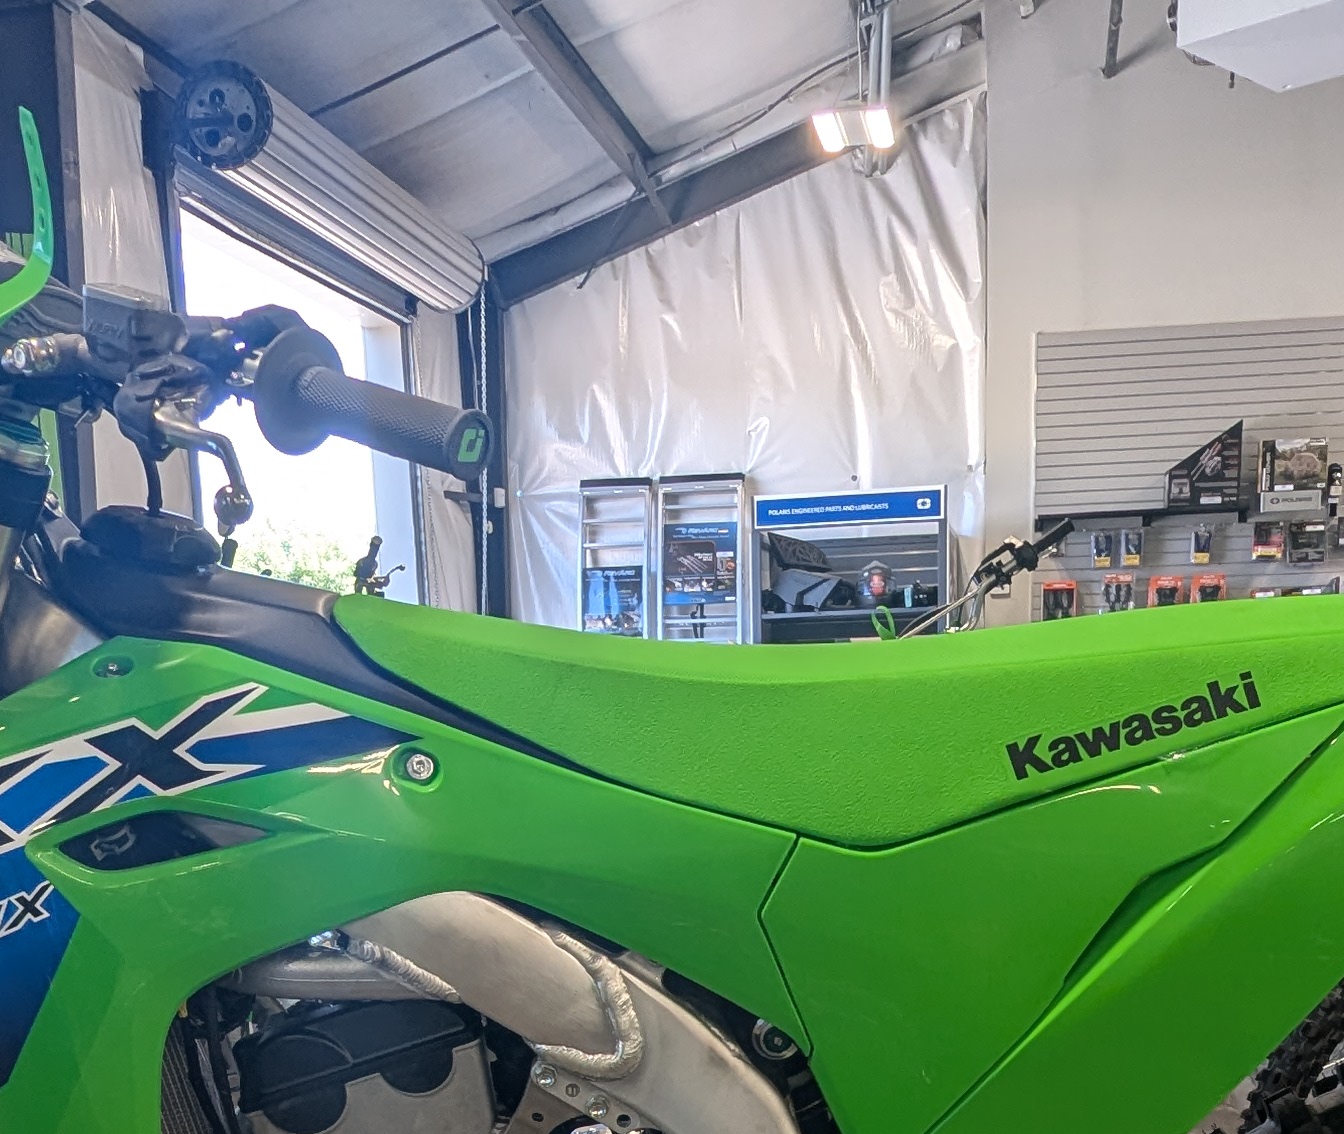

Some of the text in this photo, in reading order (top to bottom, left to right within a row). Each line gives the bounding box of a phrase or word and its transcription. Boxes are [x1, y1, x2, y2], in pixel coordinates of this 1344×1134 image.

[768, 508, 791, 516] POLARIS
[825, 505, 842, 513] PARTS
[842, 504, 855, 512] AND
[1005, 670, 1262, 781] Kawasaki
